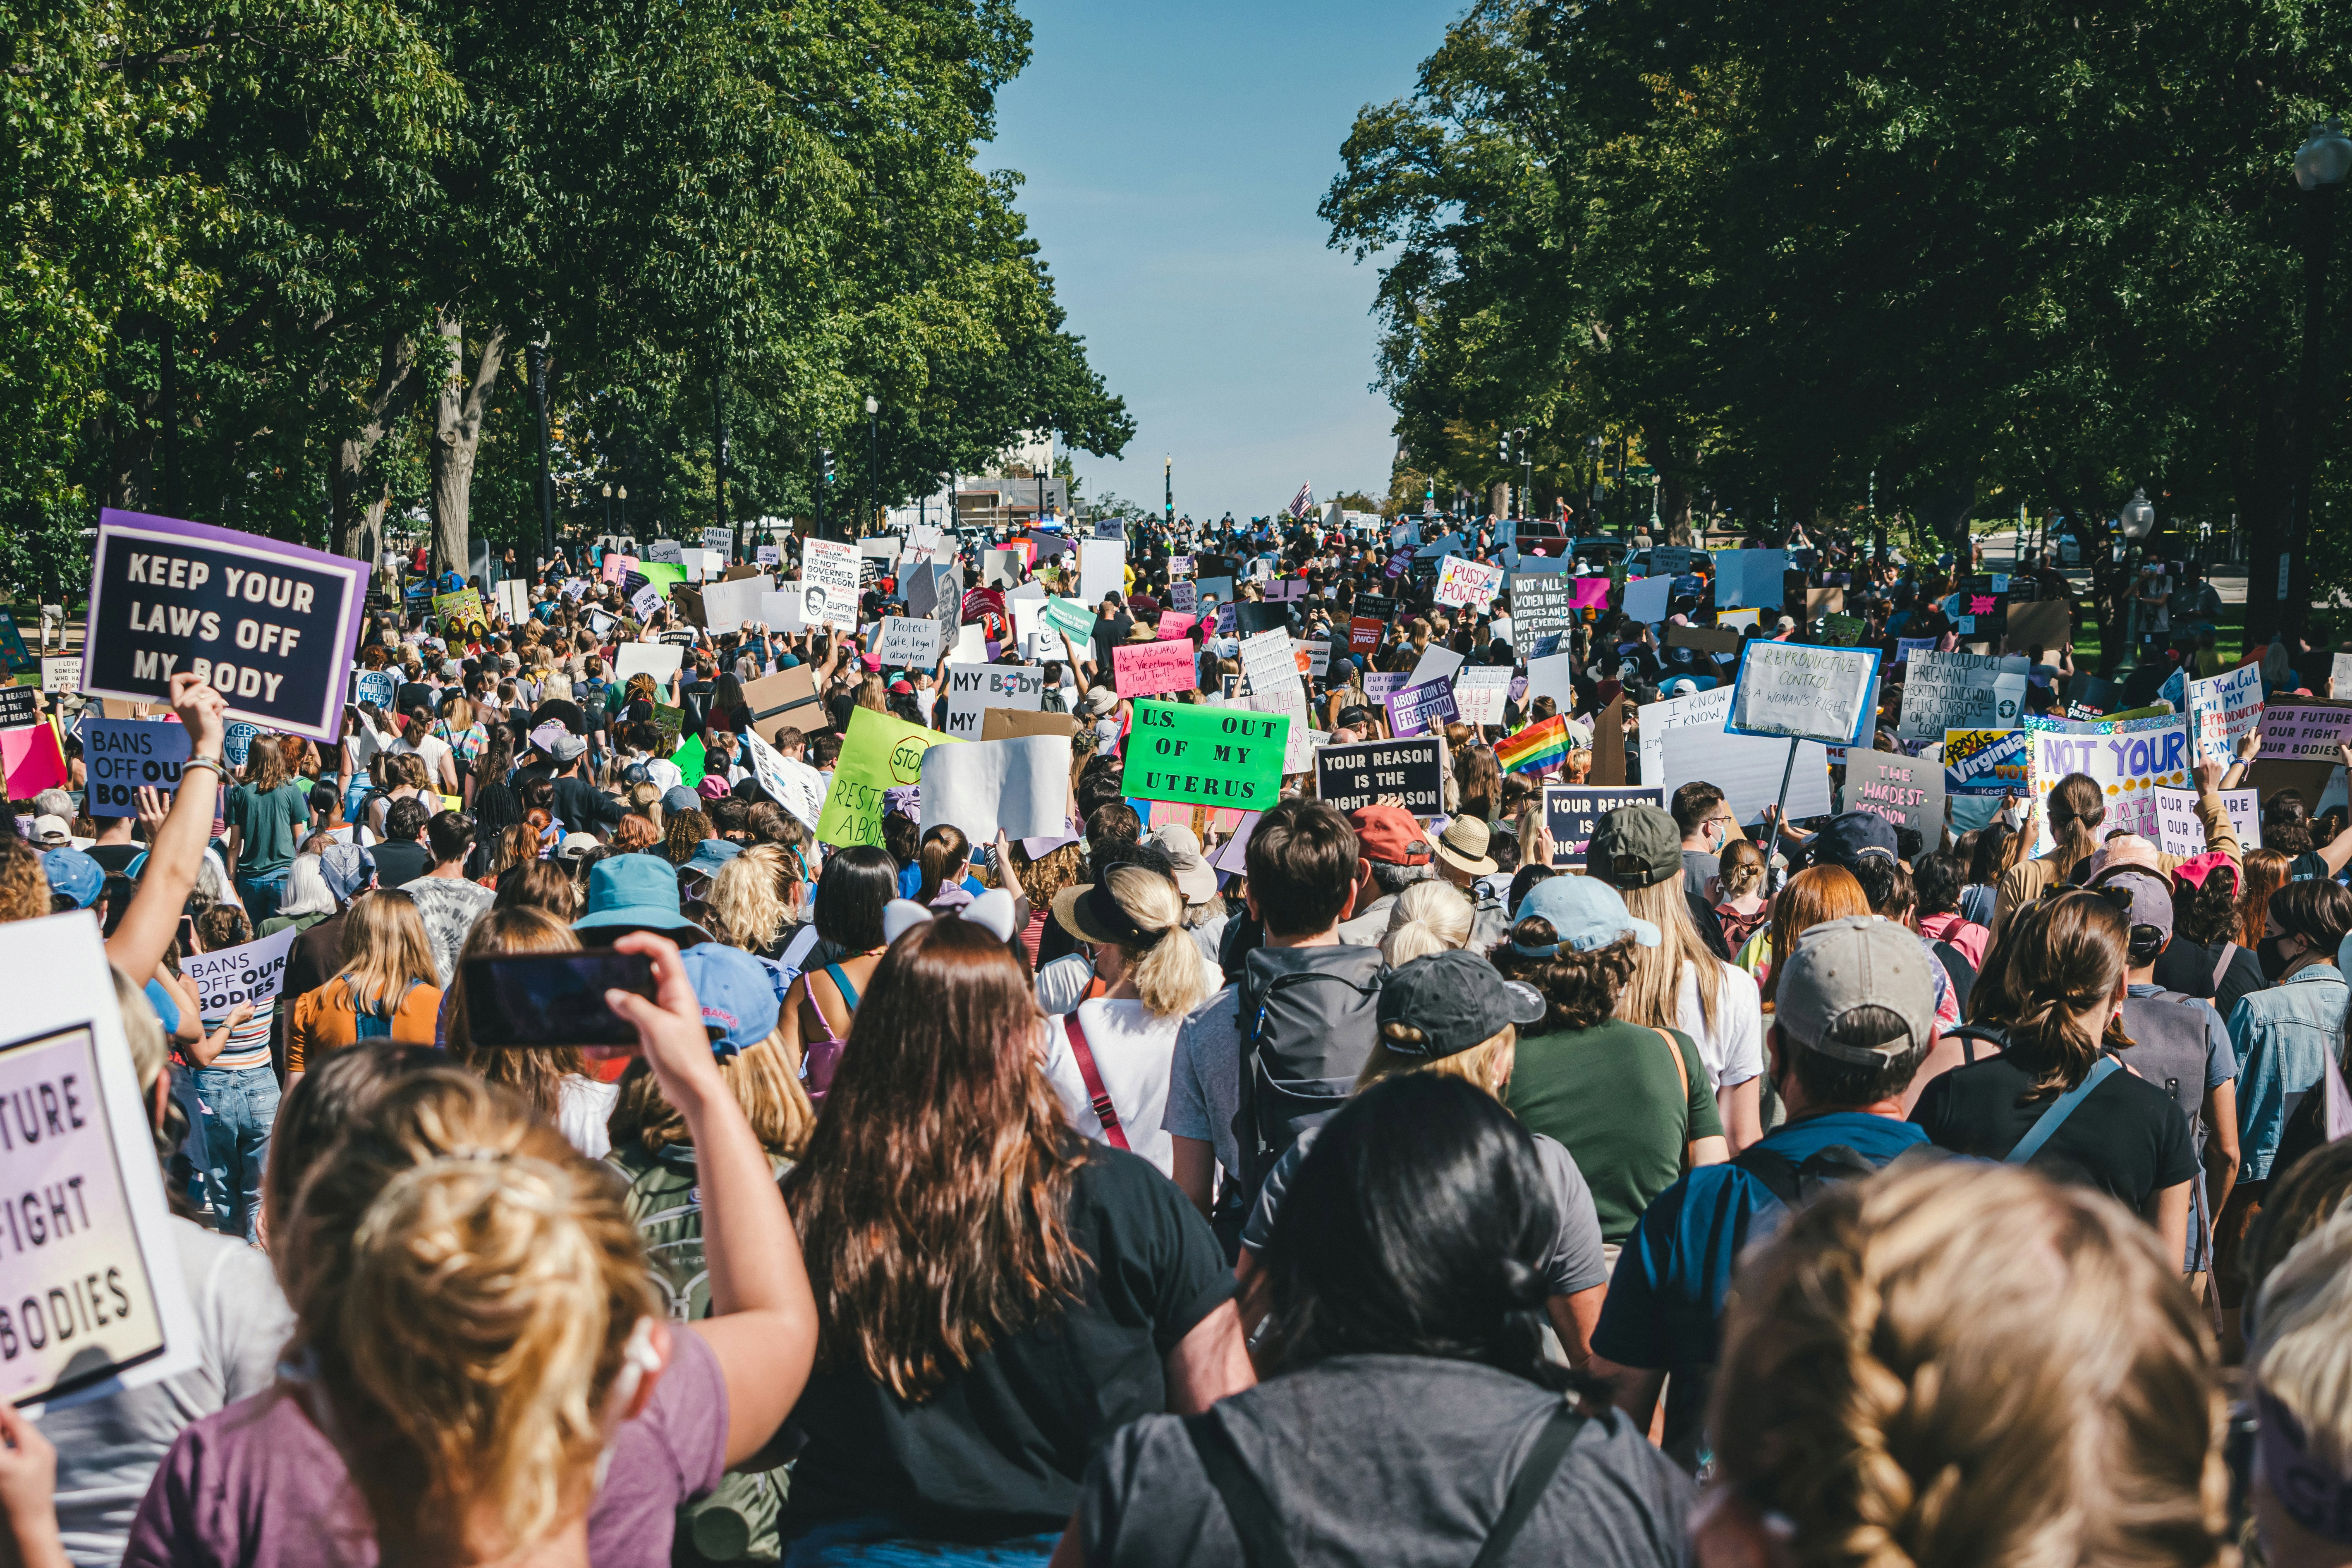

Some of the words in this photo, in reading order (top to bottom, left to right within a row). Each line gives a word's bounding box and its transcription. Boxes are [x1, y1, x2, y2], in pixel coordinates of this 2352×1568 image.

[707, 529, 730, 538] Mind
[811, 541, 850, 553] ABORTION
[808, 565, 853, 579] GOVERNED
[821, 560, 837, 569] NOT
[128, 553, 209, 590] KEEP
[225, 567, 314, 613] YOUR
[820, 576, 855, 588] REASON
[1452, 565, 1489, 586] PUSSY
[1516, 579, 1536, 592] NOT
[1542, 578, 1562, 591] ALL
[642, 594, 656, 605] OUR
[1443, 582, 1489, 606] POWER
[1513, 594, 1543, 607] WOMEN
[1546, 594, 1567, 605] HAVE
[827, 601, 857, 614] SUPPORT
[1050, 603, 1072, 618] Women's
[1073, 616, 1090, 627] Health
[1513, 608, 1546, 619] UTERUSES
[1548, 606, 1568, 616] AND
[1050, 609, 1073, 625] Protection
[1515, 619, 1529, 631] NOT
[1532, 618, 1570, 628] EVERYONE
[129, 601, 221, 642] LAWS
[235, 619, 300, 657] OFF
[893, 619, 930, 632] Protect
[912, 637, 934, 651] legal
[1353, 635, 1375, 644] ywca
[1520, 642, 1528, 653] IS
[890, 650, 924, 661] abortion
[1143, 645, 1177, 658] ABOARD
[1908, 648, 1921, 662] IF
[1924, 650, 1944, 665] MEN
[1951, 653, 1981, 668] COULD
[1984, 656, 2005, 670] GET
[1120, 663, 1132, 672] the
[1764, 649, 1857, 673] REPRODUCTIVE
[133, 650, 178, 682] MY
[193, 657, 283, 702] BODY
[366, 673, 387, 685] KEEP
[1132, 671, 1146, 682] Toot
[1780, 670, 1835, 690] CONTROL
[2190, 681, 2207, 699] IF
[2213, 678, 2235, 694] You
[2237, 668, 2258, 688] Cut
[359, 684, 392, 696] ABORTION
[954, 673, 983, 691] MY
[990, 672, 1043, 697] BODY
[6, 691, 31, 700] REASON
[1274, 690, 1299, 708] THE
[1393, 683, 1438, 709] ABORTION
[1438, 681, 1447, 693] IS
[1741, 686, 1750, 698] IS
[1753, 689, 1761, 697] A
[1768, 691, 1811, 706] WOMAN'S
[1815, 697, 1850, 714] RIGHT
[1904, 684, 1937, 697] ABORTION
[1939, 685, 1971, 701] CLINICS
[1972, 687, 1994, 703] WOULD
[2199, 698, 2220, 711] OFF
[2225, 691, 2244, 709] MY
[1669, 701, 1680, 716] I
[1689, 690, 1725, 710] KNOW
[1903, 698, 1914, 710] BE
[1917, 699, 1933, 712] LIKE
[1397, 697, 1452, 728] FREEDOM
[1684, 708, 1723, 726] KNOW,
[1910, 711, 1924, 723] ONE
[1930, 713, 1940, 724] ON
[1944, 714, 1966, 727] EVERY
[2268, 711, 2295, 721] OUR
[2300, 712, 2352, 724] FUTURE
[950, 712, 976, 731] MY
[1142, 709, 1175, 728] U.S.
[1222, 717, 1276, 738] OUT
[232, 724, 256, 737] KEEP
[2268, 726, 2295, 737] OUR
[2302, 728, 2341, 740] FIGHT
[92, 730, 152, 755] BANS
[2260, 742, 2286, 753] OUR
[2292, 744, 2340, 756] BODIES
[1156, 738, 1188, 756] OF
[1213, 745, 1251, 764] MY
[1945, 733, 2025, 783] Virginia
[2044, 739, 2097, 776] NOT
[2108, 732, 2185, 776] YOUR
[1325, 754, 1366, 771] YOUR
[1373, 749, 1432, 766] REASON
[95, 757, 137, 779] OFF
[143, 760, 184, 782] OU
[1878, 765, 1913, 782] THE
[1146, 772, 1255, 798] UTERUS
[1355, 775, 1369, 788] IS
[1376, 771, 1405, 786] THE
[1864, 781, 1924, 806] HARDEST
[1553, 798, 1591, 813] YOUR
[2161, 796, 2182, 812] OUR
[1580, 820, 1594, 833] IS
[2168, 820, 2188, 835] OUR
[2167, 841, 2186, 857] OUR
[192, 953, 249, 978] BANS
[198, 974, 235, 994] OFF
[241, 956, 285, 984] OUR
[200, 977, 275, 1012] BODIES
